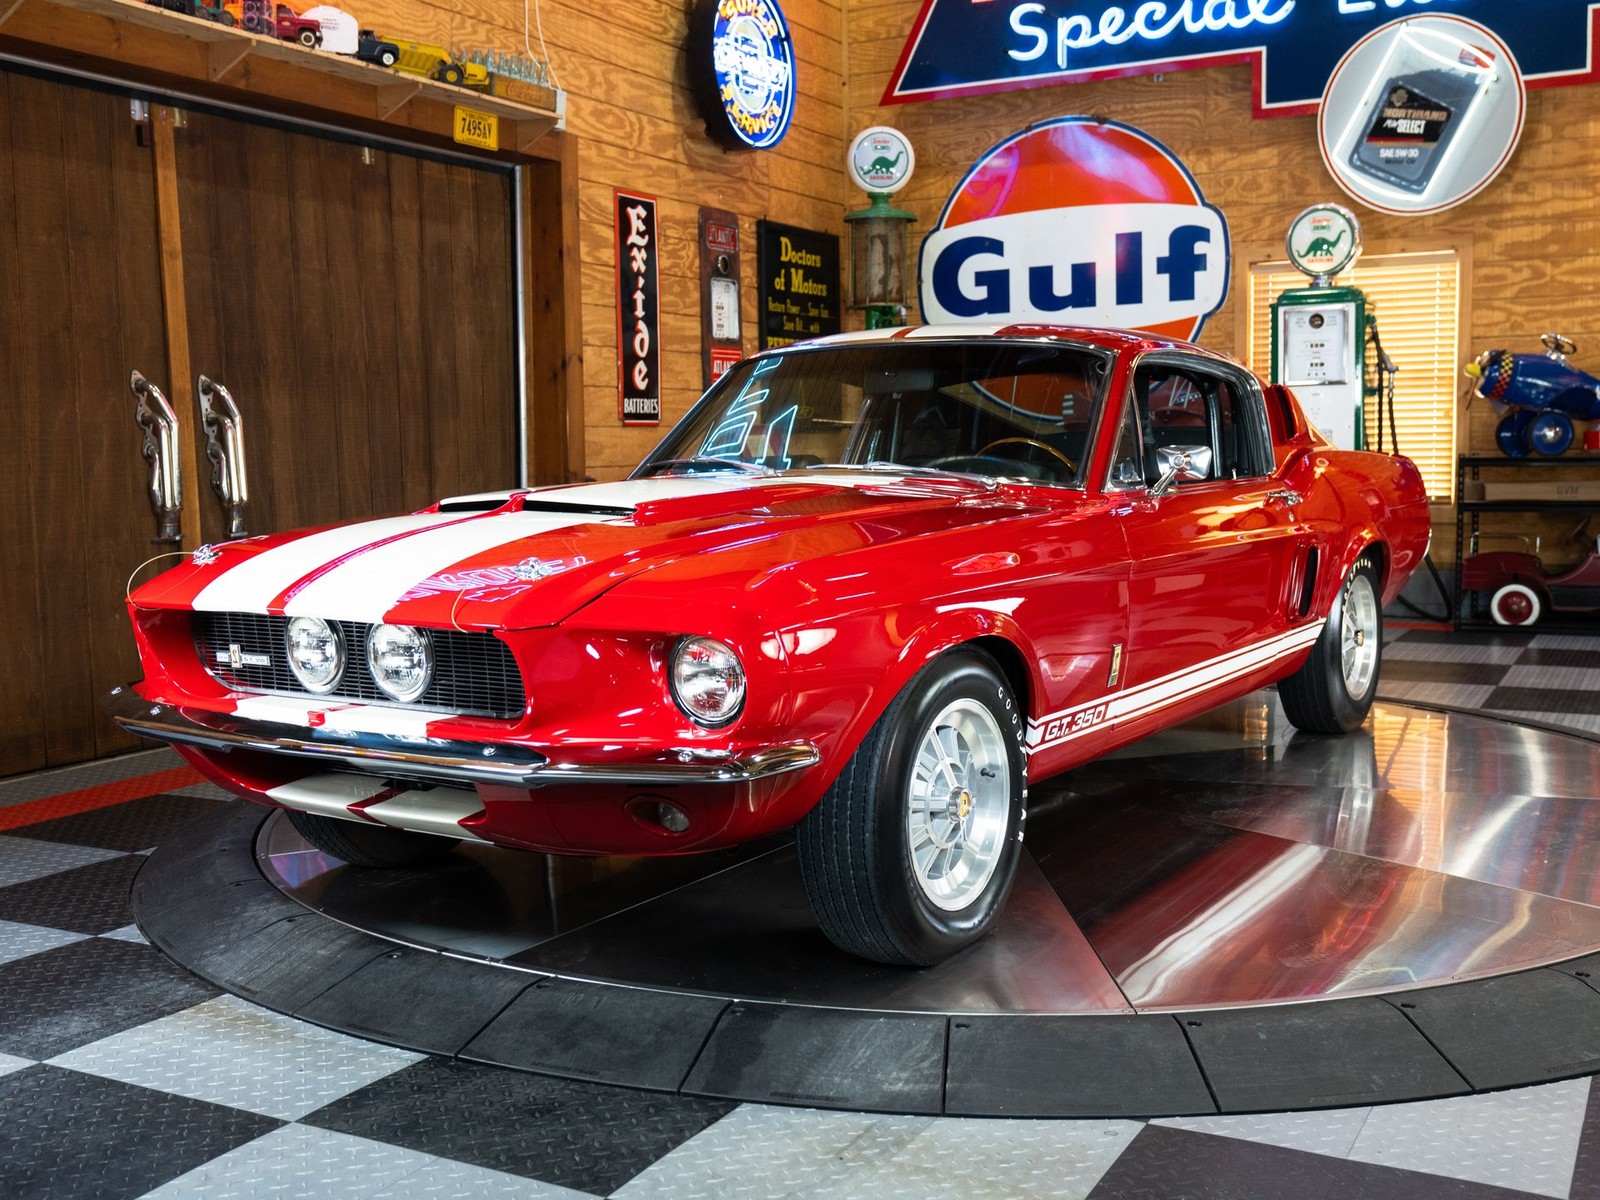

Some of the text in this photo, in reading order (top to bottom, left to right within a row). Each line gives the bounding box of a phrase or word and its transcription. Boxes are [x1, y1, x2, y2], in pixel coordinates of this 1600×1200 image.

[1008, 0, 1295, 69] Special
[461, 117, 493, 140] 7495AV
[1397, 119, 1427, 135] SELECT
[780, 236, 821, 267] Doctors
[774, 267, 827, 296] of Motors
[932, 225, 1211, 318] Gulf
[626, 204, 650, 391] Exide
[623, 397, 659, 415] BATTERIES
